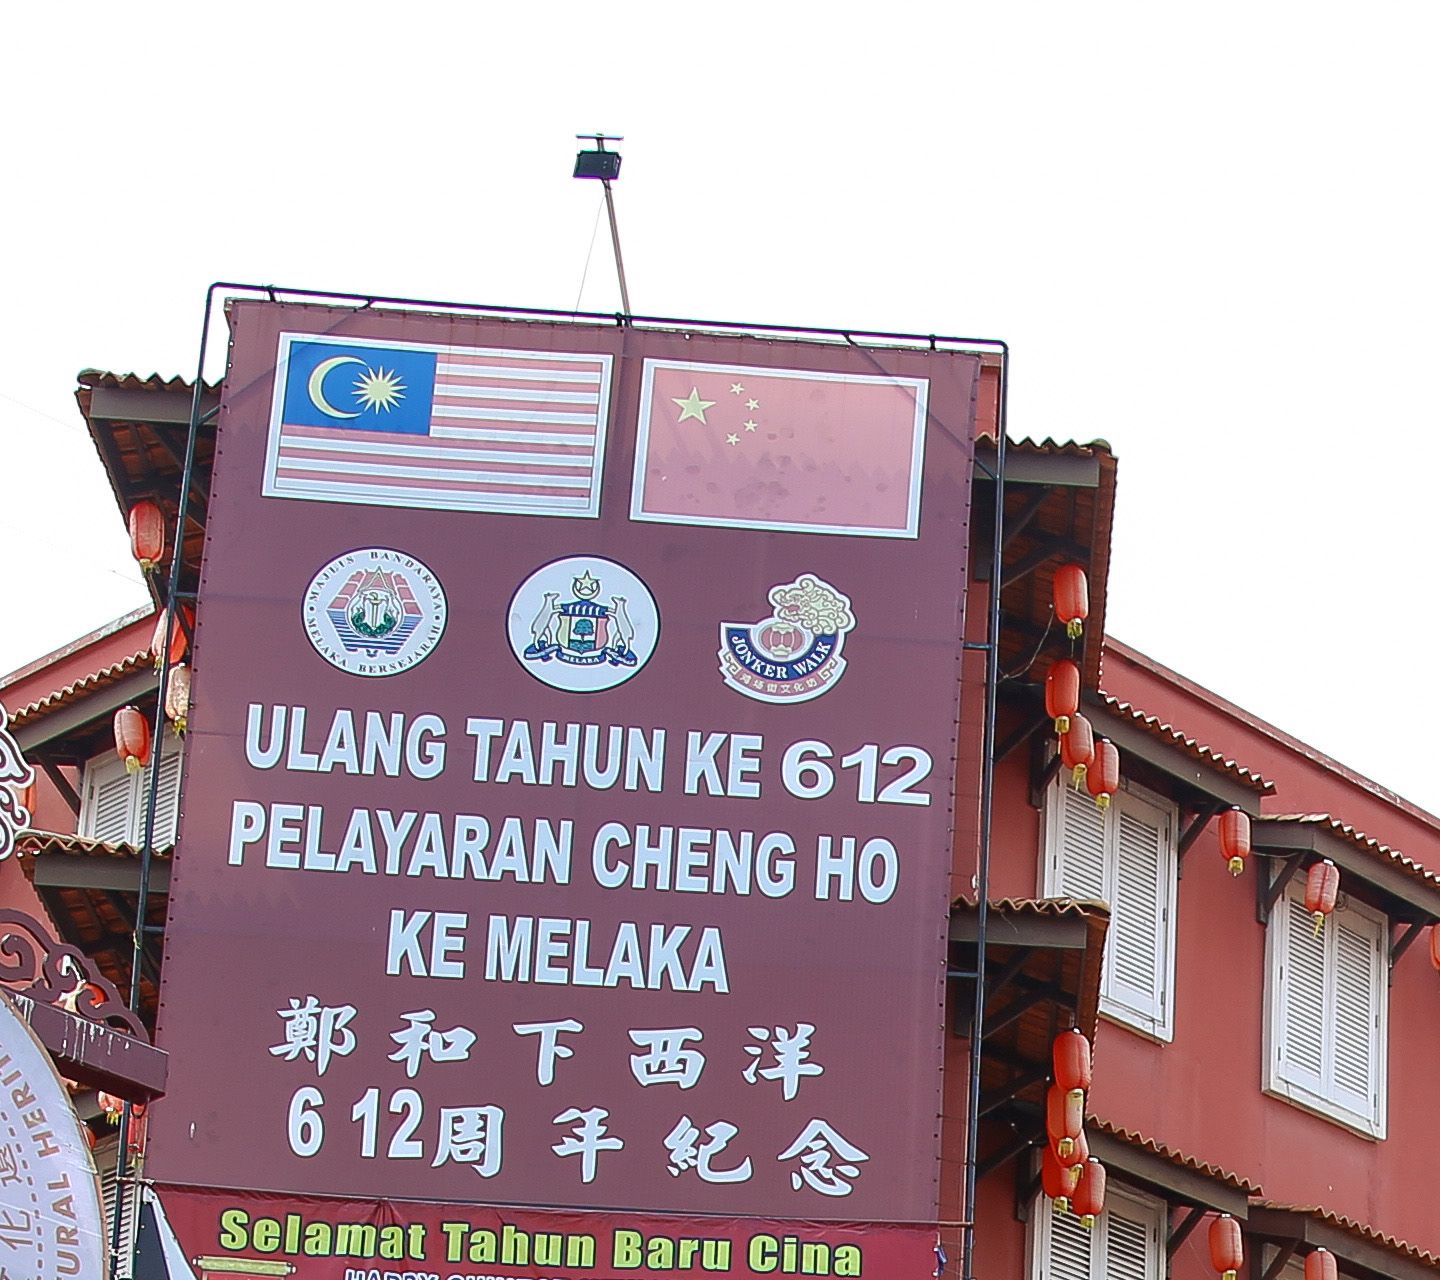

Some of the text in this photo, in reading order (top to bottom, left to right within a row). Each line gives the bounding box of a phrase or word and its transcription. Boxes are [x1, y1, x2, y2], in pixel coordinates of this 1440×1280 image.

[309, 550, 442, 612] MAJLIS BANDARAYA
[306, 616, 441, 674] MELAKA BERSEJARAH
[731, 634, 833, 680] JONKER WALK
[243, 702, 934, 807] ULANG TAHUN KE 612
[228, 800, 900, 904] PELAYARAN CHENG HO
[384, 909, 731, 995] KE MELAKA
[268, 995, 825, 1104] 鄭和下西洋
[218, 1207, 864, 1278] Selamat Tahun Baru Cina
